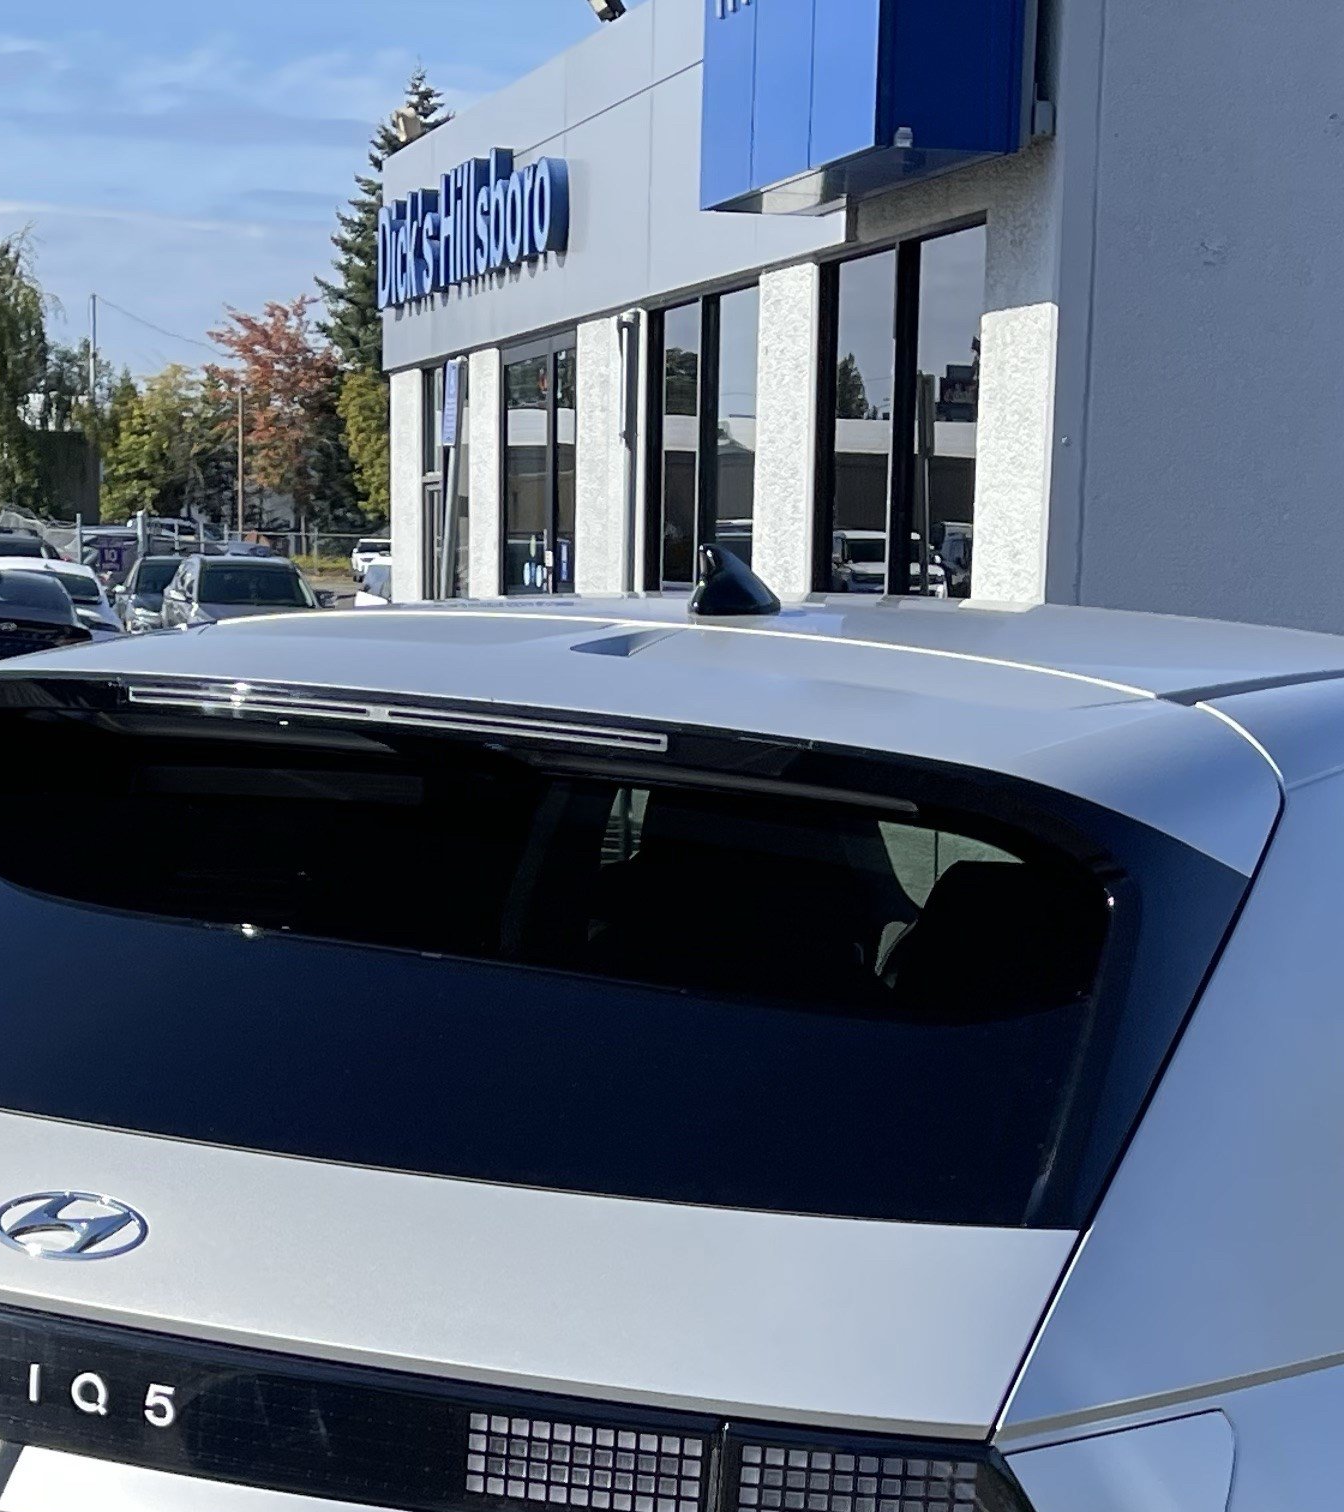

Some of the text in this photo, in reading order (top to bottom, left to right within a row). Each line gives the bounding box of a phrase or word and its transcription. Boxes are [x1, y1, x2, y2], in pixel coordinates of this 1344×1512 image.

[377, 147, 552, 309] Dick's Hillsboro
[143, 1382, 176, 1427] 5
